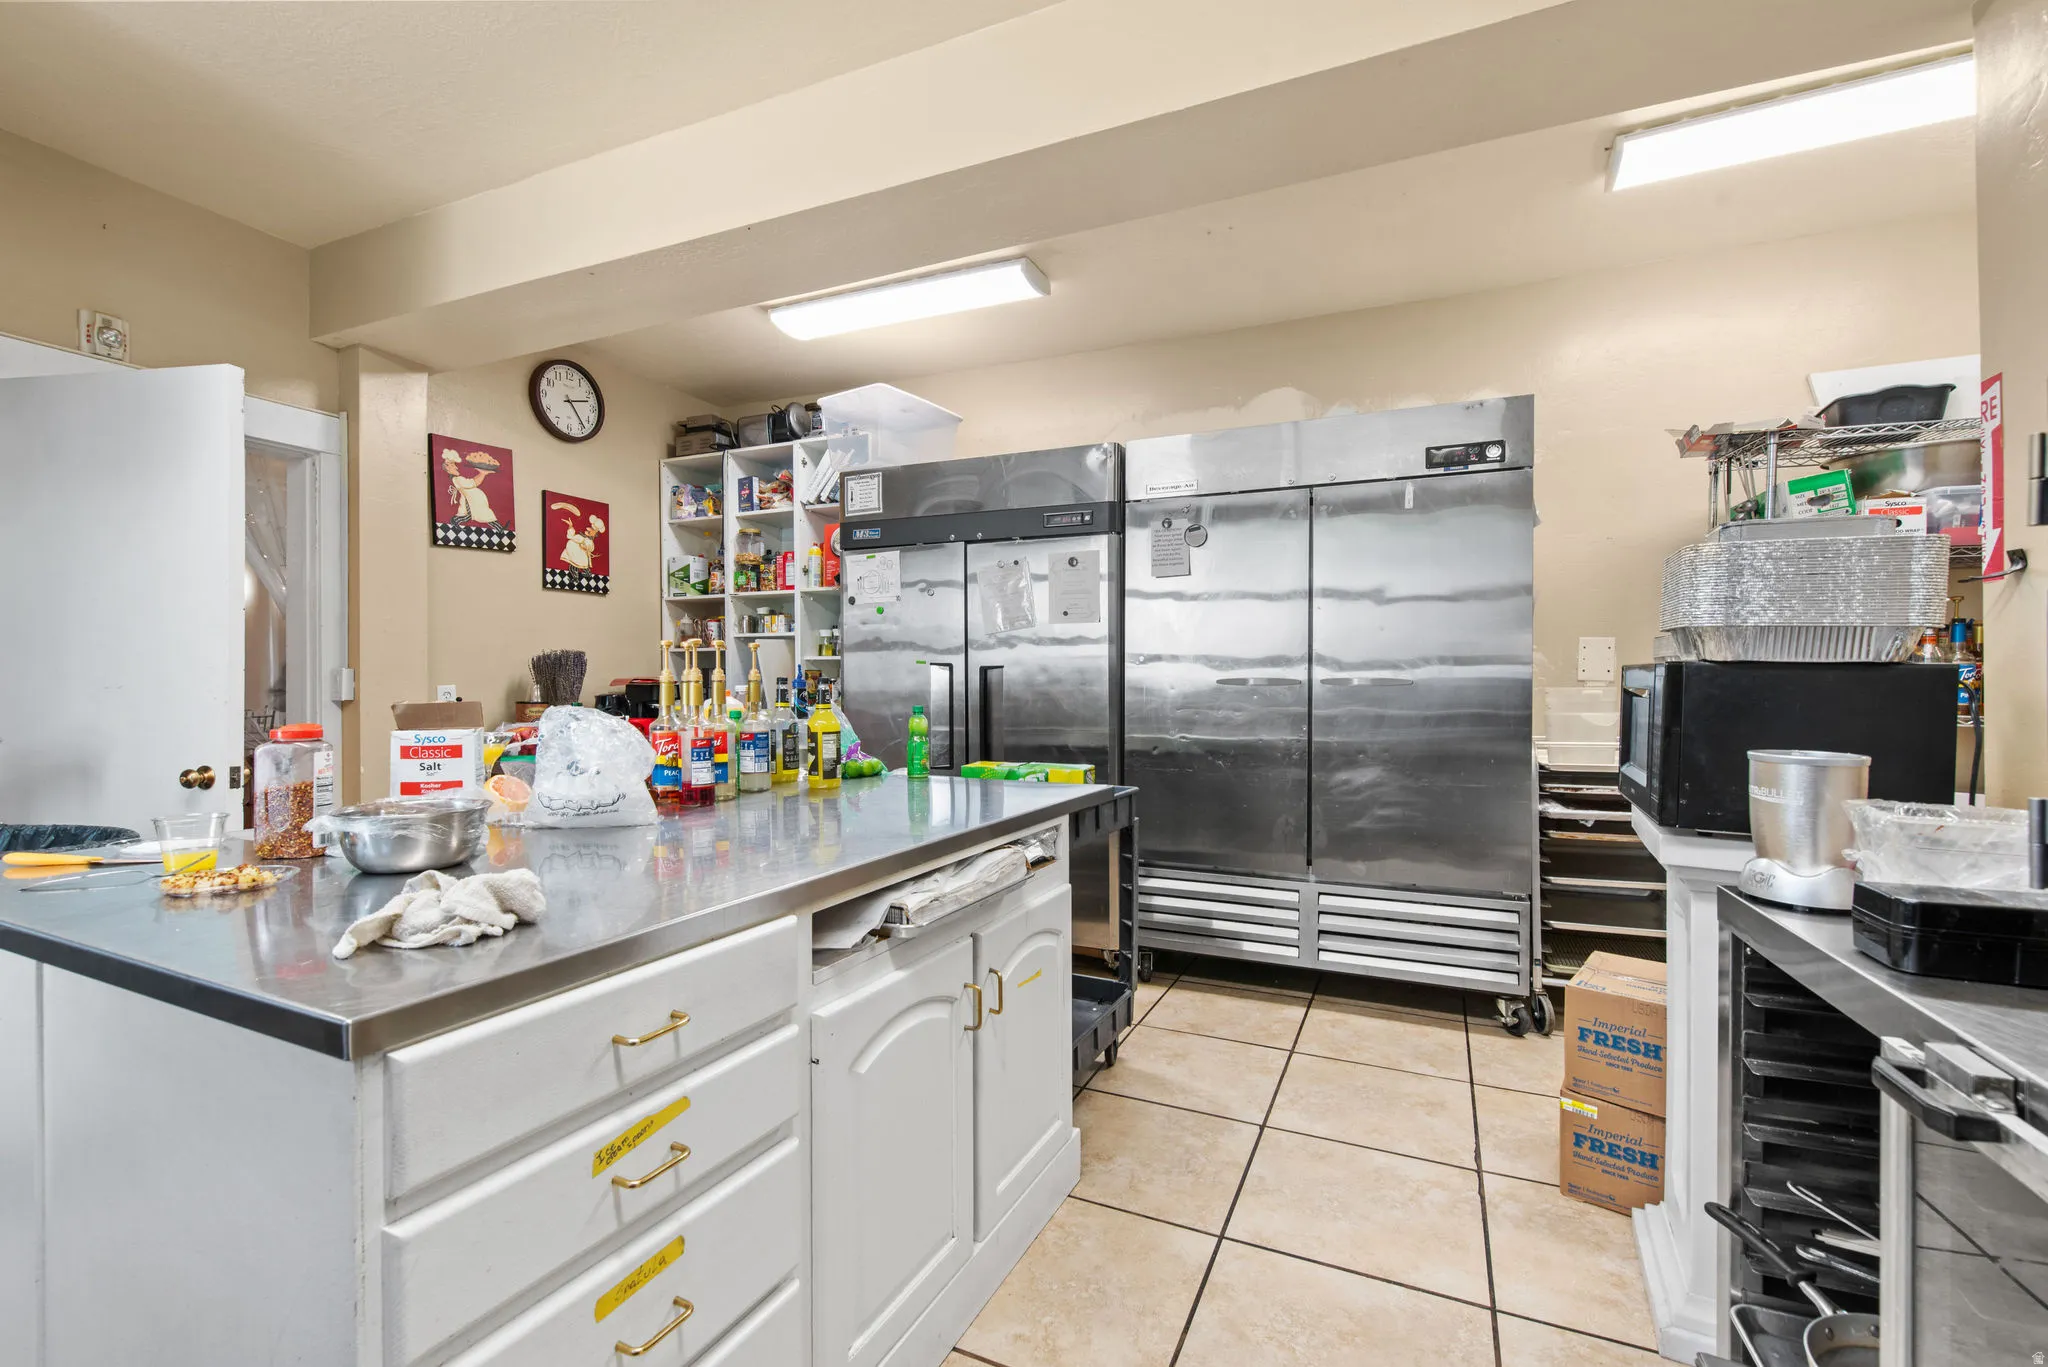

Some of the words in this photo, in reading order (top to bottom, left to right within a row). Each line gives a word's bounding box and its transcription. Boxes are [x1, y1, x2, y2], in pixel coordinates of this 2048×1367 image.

[554, 371, 562, 381] 11
[565, 371, 574, 381] 12
[546, 378, 555, 388] 10
[578, 379, 581, 388] 1
[541, 389, 547, 398] 9
[585, 391, 591, 399] 2
[545, 404, 552, 412] 8
[567, 423, 572, 432] 6
[1880, 508, 1910, 516] Classic
[414, 733, 446, 745] Sysco
[409, 746, 452, 759] Classic
[419, 762, 442, 771] Salt
[1592, 1017, 1647, 1039] Imperial
[1577, 1026, 1663, 1062] FRESH
[1577, 1045, 1598, 1056] Hand
[1599, 1050, 1630, 1064] Selected
[1631, 1057, 1663, 1073] Produce
[1587, 1124, 1643, 1147] Imperial
[1573, 1131, 1659, 1171] FRESH
[1573, 1150, 1594, 1162] Hand
[1595, 1157, 1625, 1172] Selected
[1627, 1166, 1659, 1182] Produce
